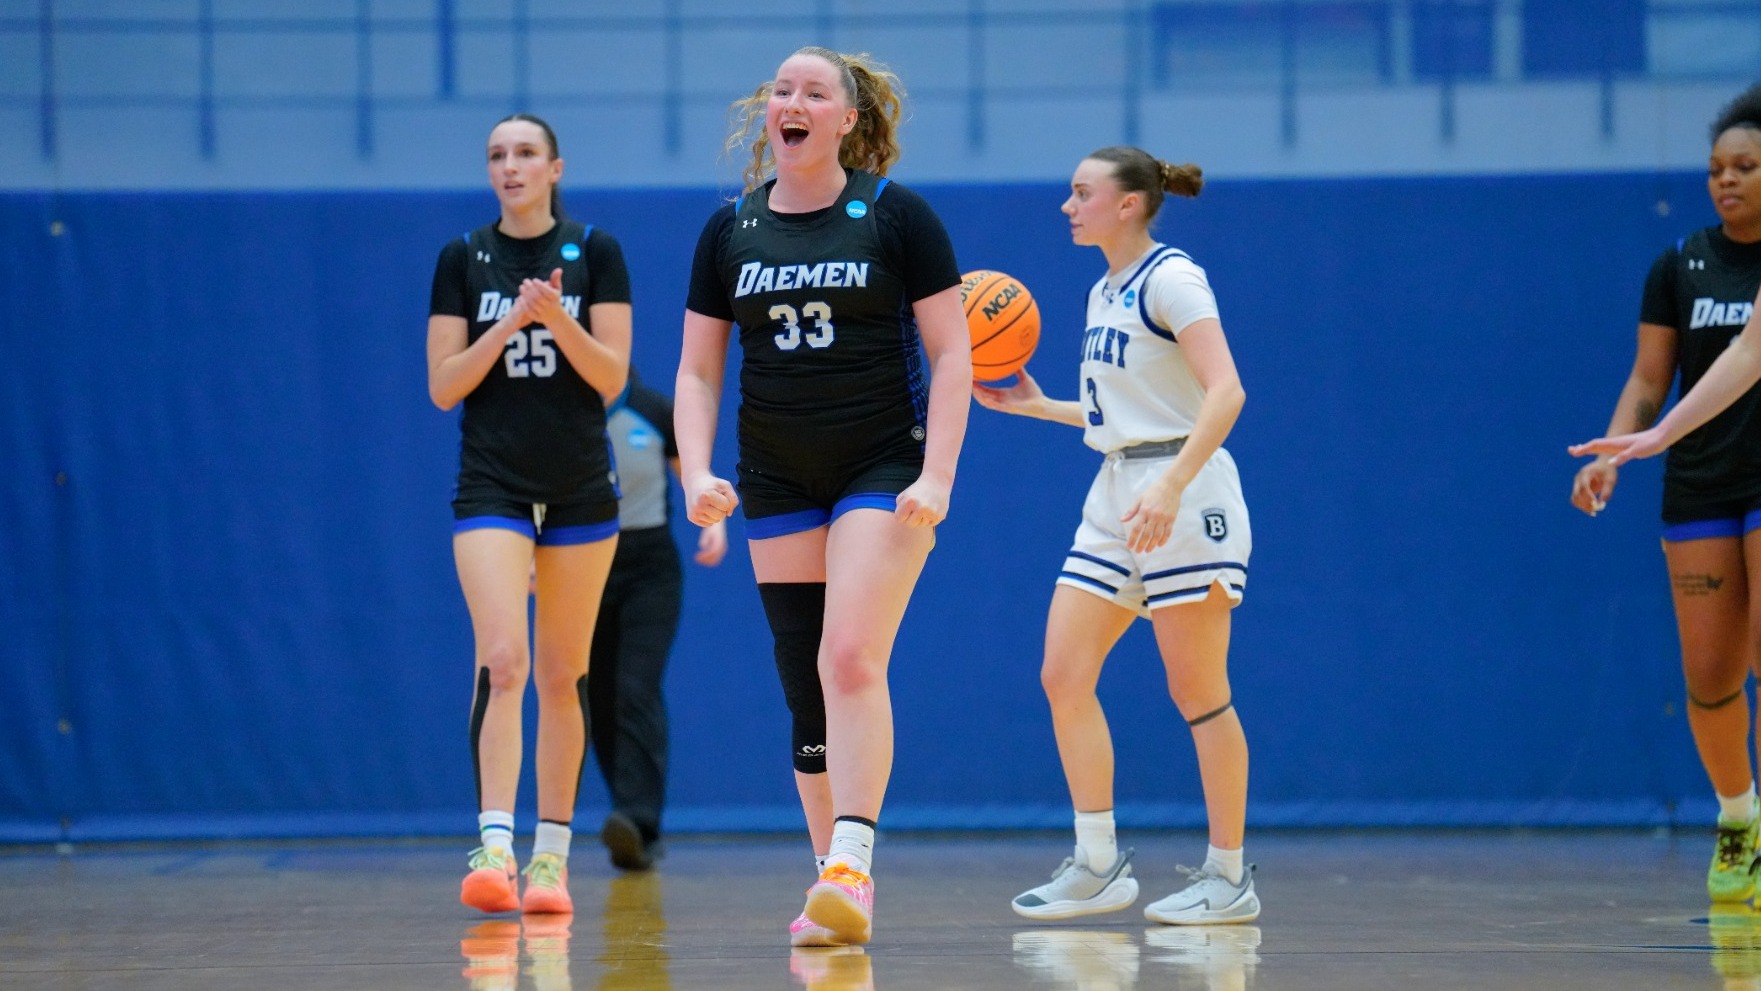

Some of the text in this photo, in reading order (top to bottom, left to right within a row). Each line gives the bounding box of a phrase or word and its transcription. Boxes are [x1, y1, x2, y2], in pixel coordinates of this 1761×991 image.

[735, 262, 869, 298] DAEMEN
[476, 291, 581, 322] DAN
[982, 283, 1022, 322] NCAA
[768, 301, 835, 350] 33
[504, 328, 556, 378] 25
[1086, 377, 1104, 426] 3
[1206, 515, 1225, 537] B
